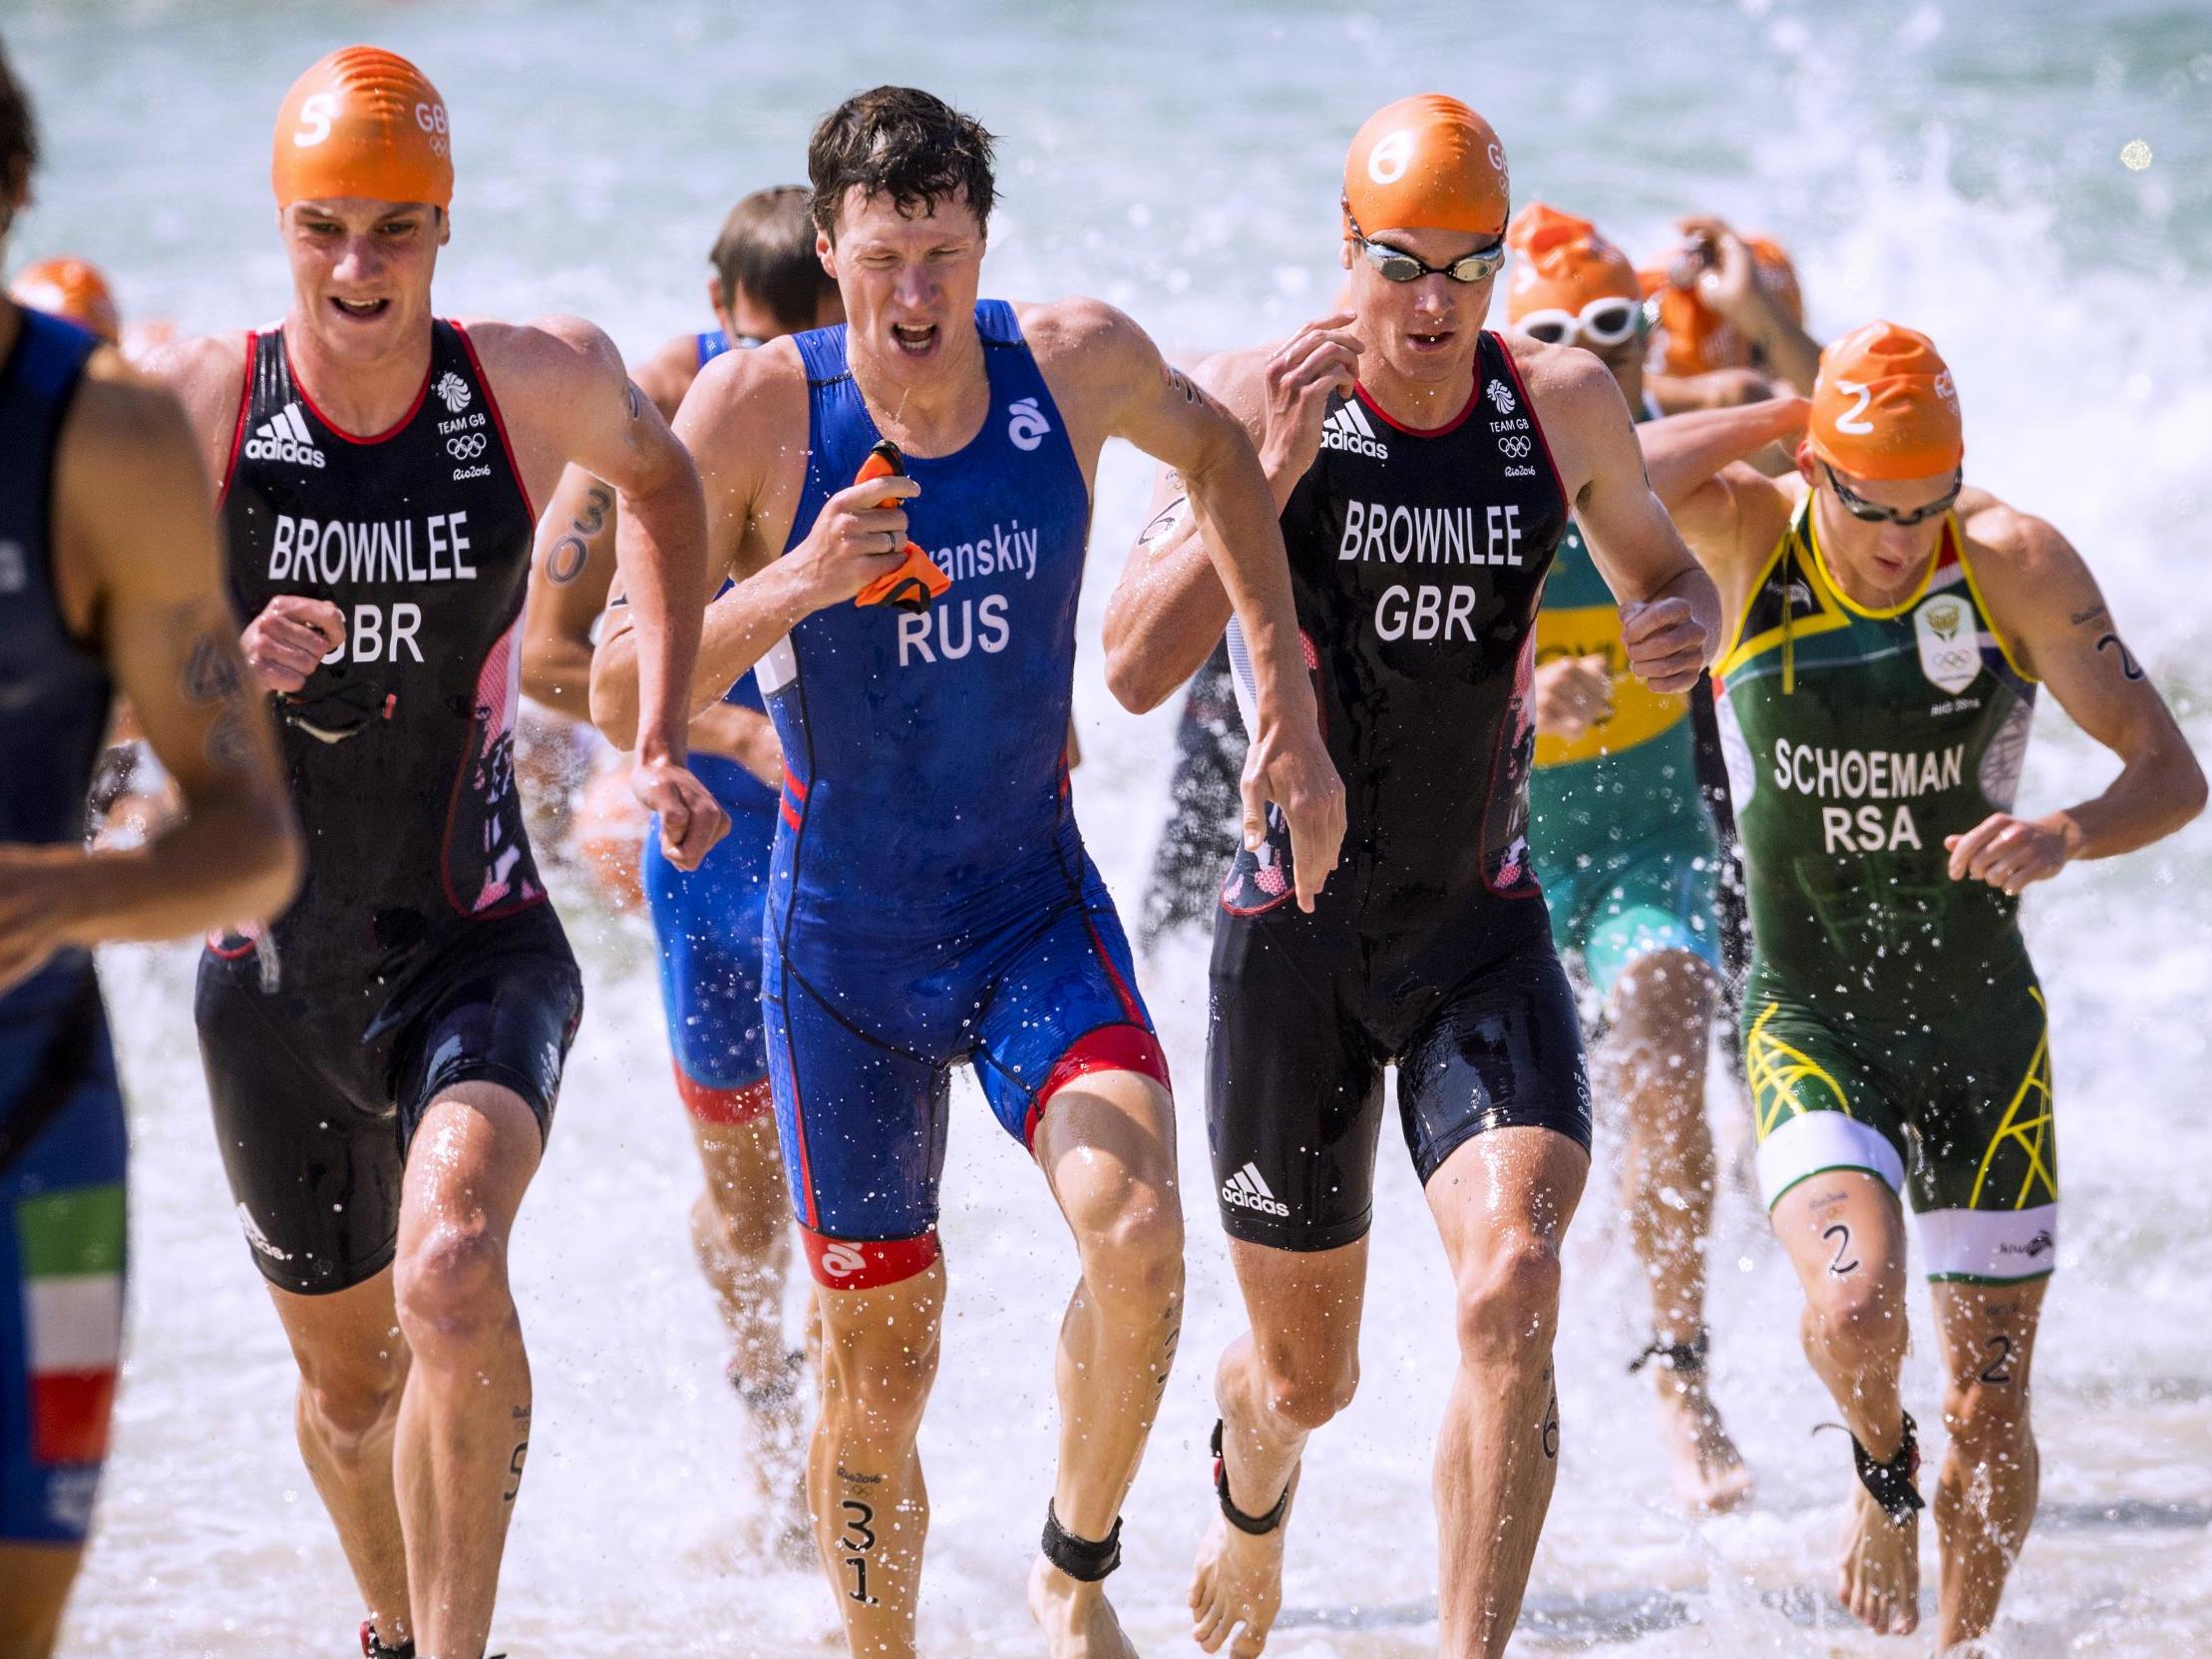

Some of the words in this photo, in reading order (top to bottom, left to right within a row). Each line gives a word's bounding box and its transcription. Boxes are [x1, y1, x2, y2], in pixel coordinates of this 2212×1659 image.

[1368, 130, 1414, 185] 6
[437, 416, 468, 436] TEAM
[469, 412, 486, 428] GB
[1489, 419, 1516, 433] TEAM
[1516, 418, 1530, 430] GB
[1835, 380, 1875, 435] 2
[244, 435, 326, 468] adidas
[453, 464, 491, 481] Rio2016
[1505, 465, 1536, 477] Rio2016
[268, 511, 478, 585] BROWNLEE
[1338, 500, 1523, 566] BROWNLEE
[899, 594, 1010, 667] RUS
[1374, 585, 1477, 641] GBR
[2097, 633, 2144, 680] 2
[1774, 737, 1965, 798] SCHOEMAN
[1822, 805, 1923, 854] RSA
[1222, 1187, 1290, 1217] adidas
[1823, 1224, 1859, 1274] 2
[1980, 1335, 2011, 1385] 2
